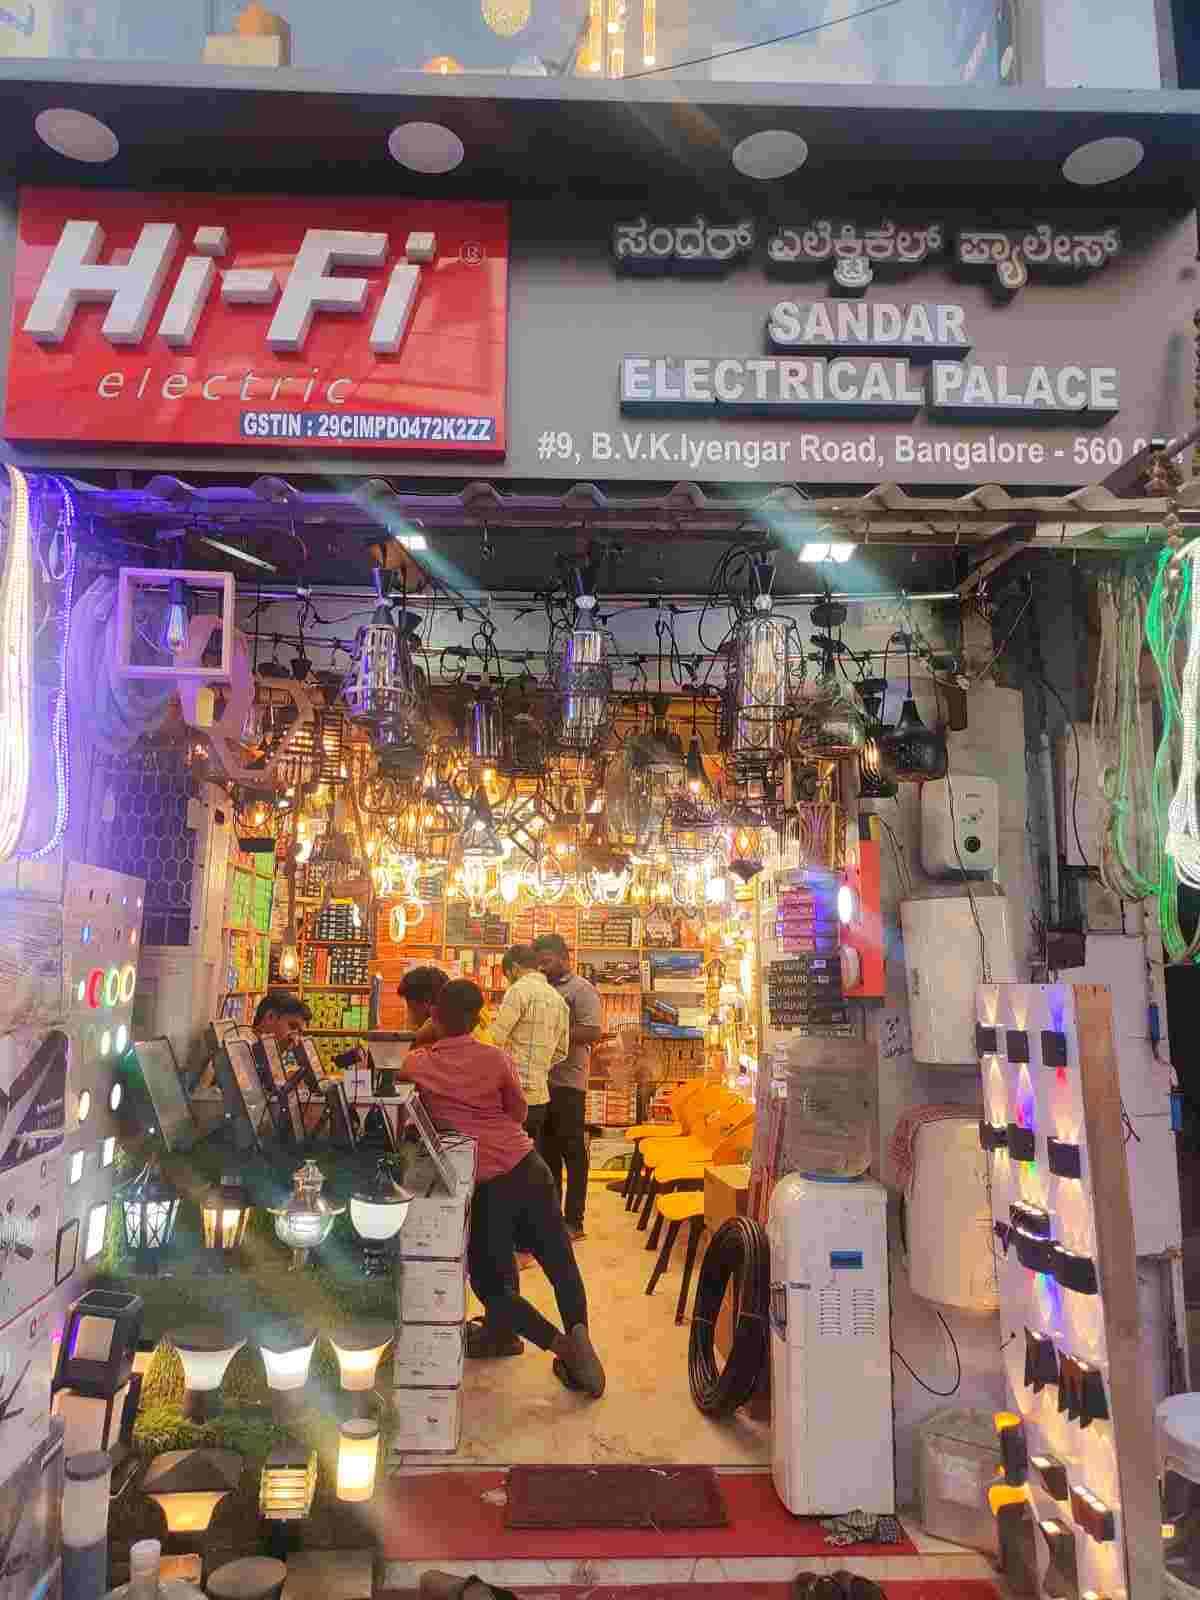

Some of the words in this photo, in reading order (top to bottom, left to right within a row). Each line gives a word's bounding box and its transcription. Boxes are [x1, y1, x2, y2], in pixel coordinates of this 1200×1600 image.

[22, 219, 437, 353] Hi-Fi
[768, 301, 968, 345] SANDAR
[97, 367, 353, 404] electric
[622, 357, 925, 403] ELECTRICAL
[932, 361, 1119, 409] PALACE
[243, 412, 301, 436] GSTIN
[537, 431, 582, 465] #9,
[592, 431, 791, 469] B.V.K.Iyengar
[800, 433, 884, 468] Road,
[895, 435, 1044, 470] Bangalore
[1073, 437, 1123, 465] 560
